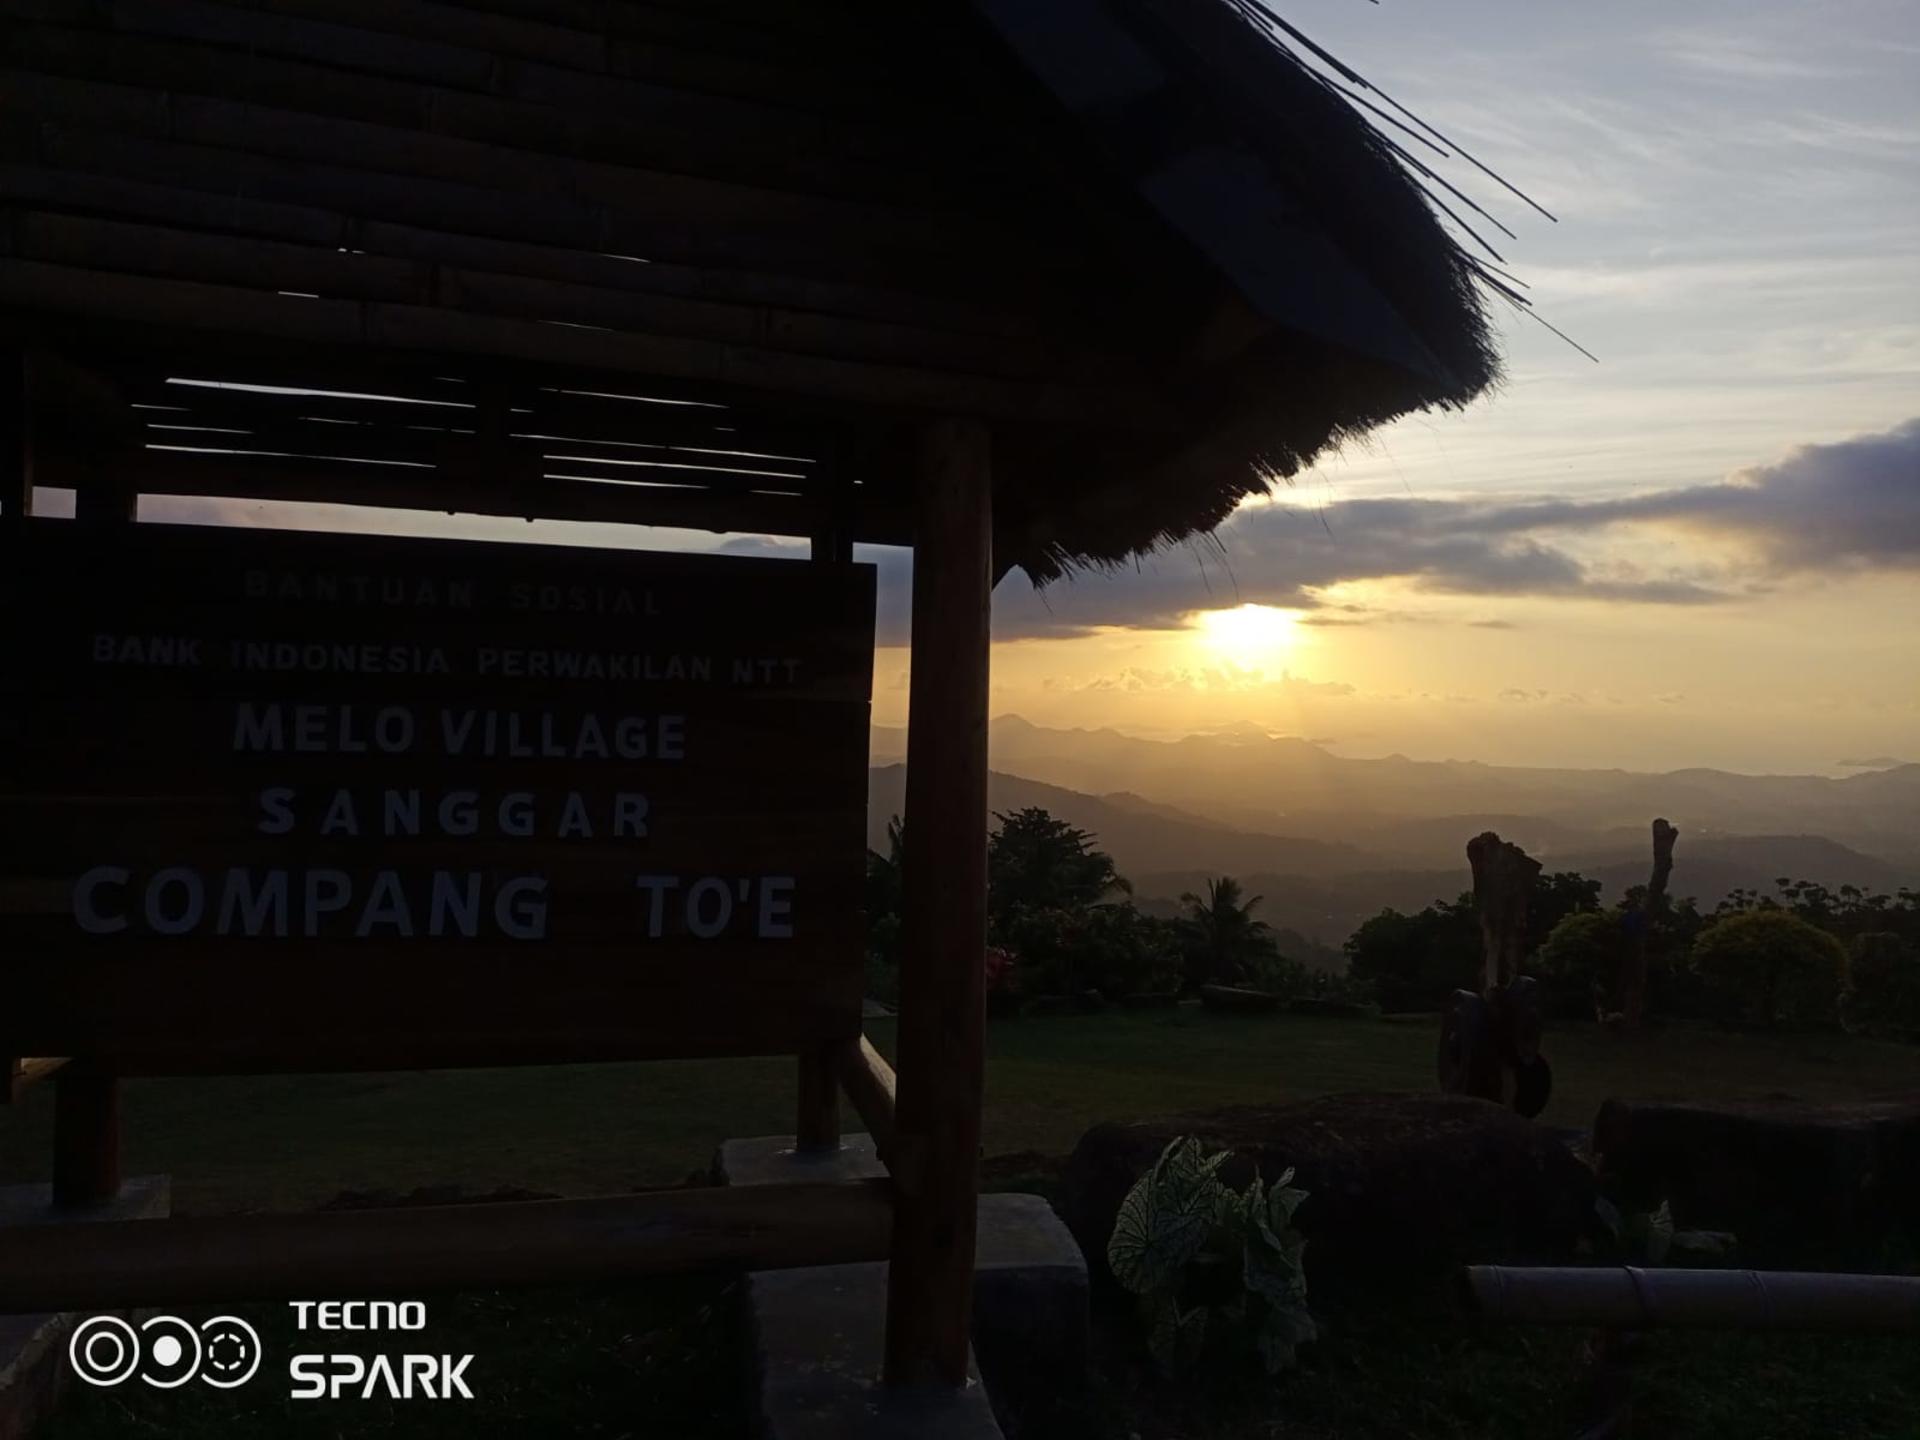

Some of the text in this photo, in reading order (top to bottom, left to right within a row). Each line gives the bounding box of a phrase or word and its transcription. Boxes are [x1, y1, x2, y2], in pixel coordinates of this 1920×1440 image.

[245, 571, 662, 617] BANTUAN SOSIAL
[94, 635, 802, 686] BANK INDONESIA PERWAKILAN NTT
[233, 702, 686, 761] MELO VILLAGE
[258, 787, 649, 838] SANGGAR
[73, 867, 795, 939] COMPANG TO'E
